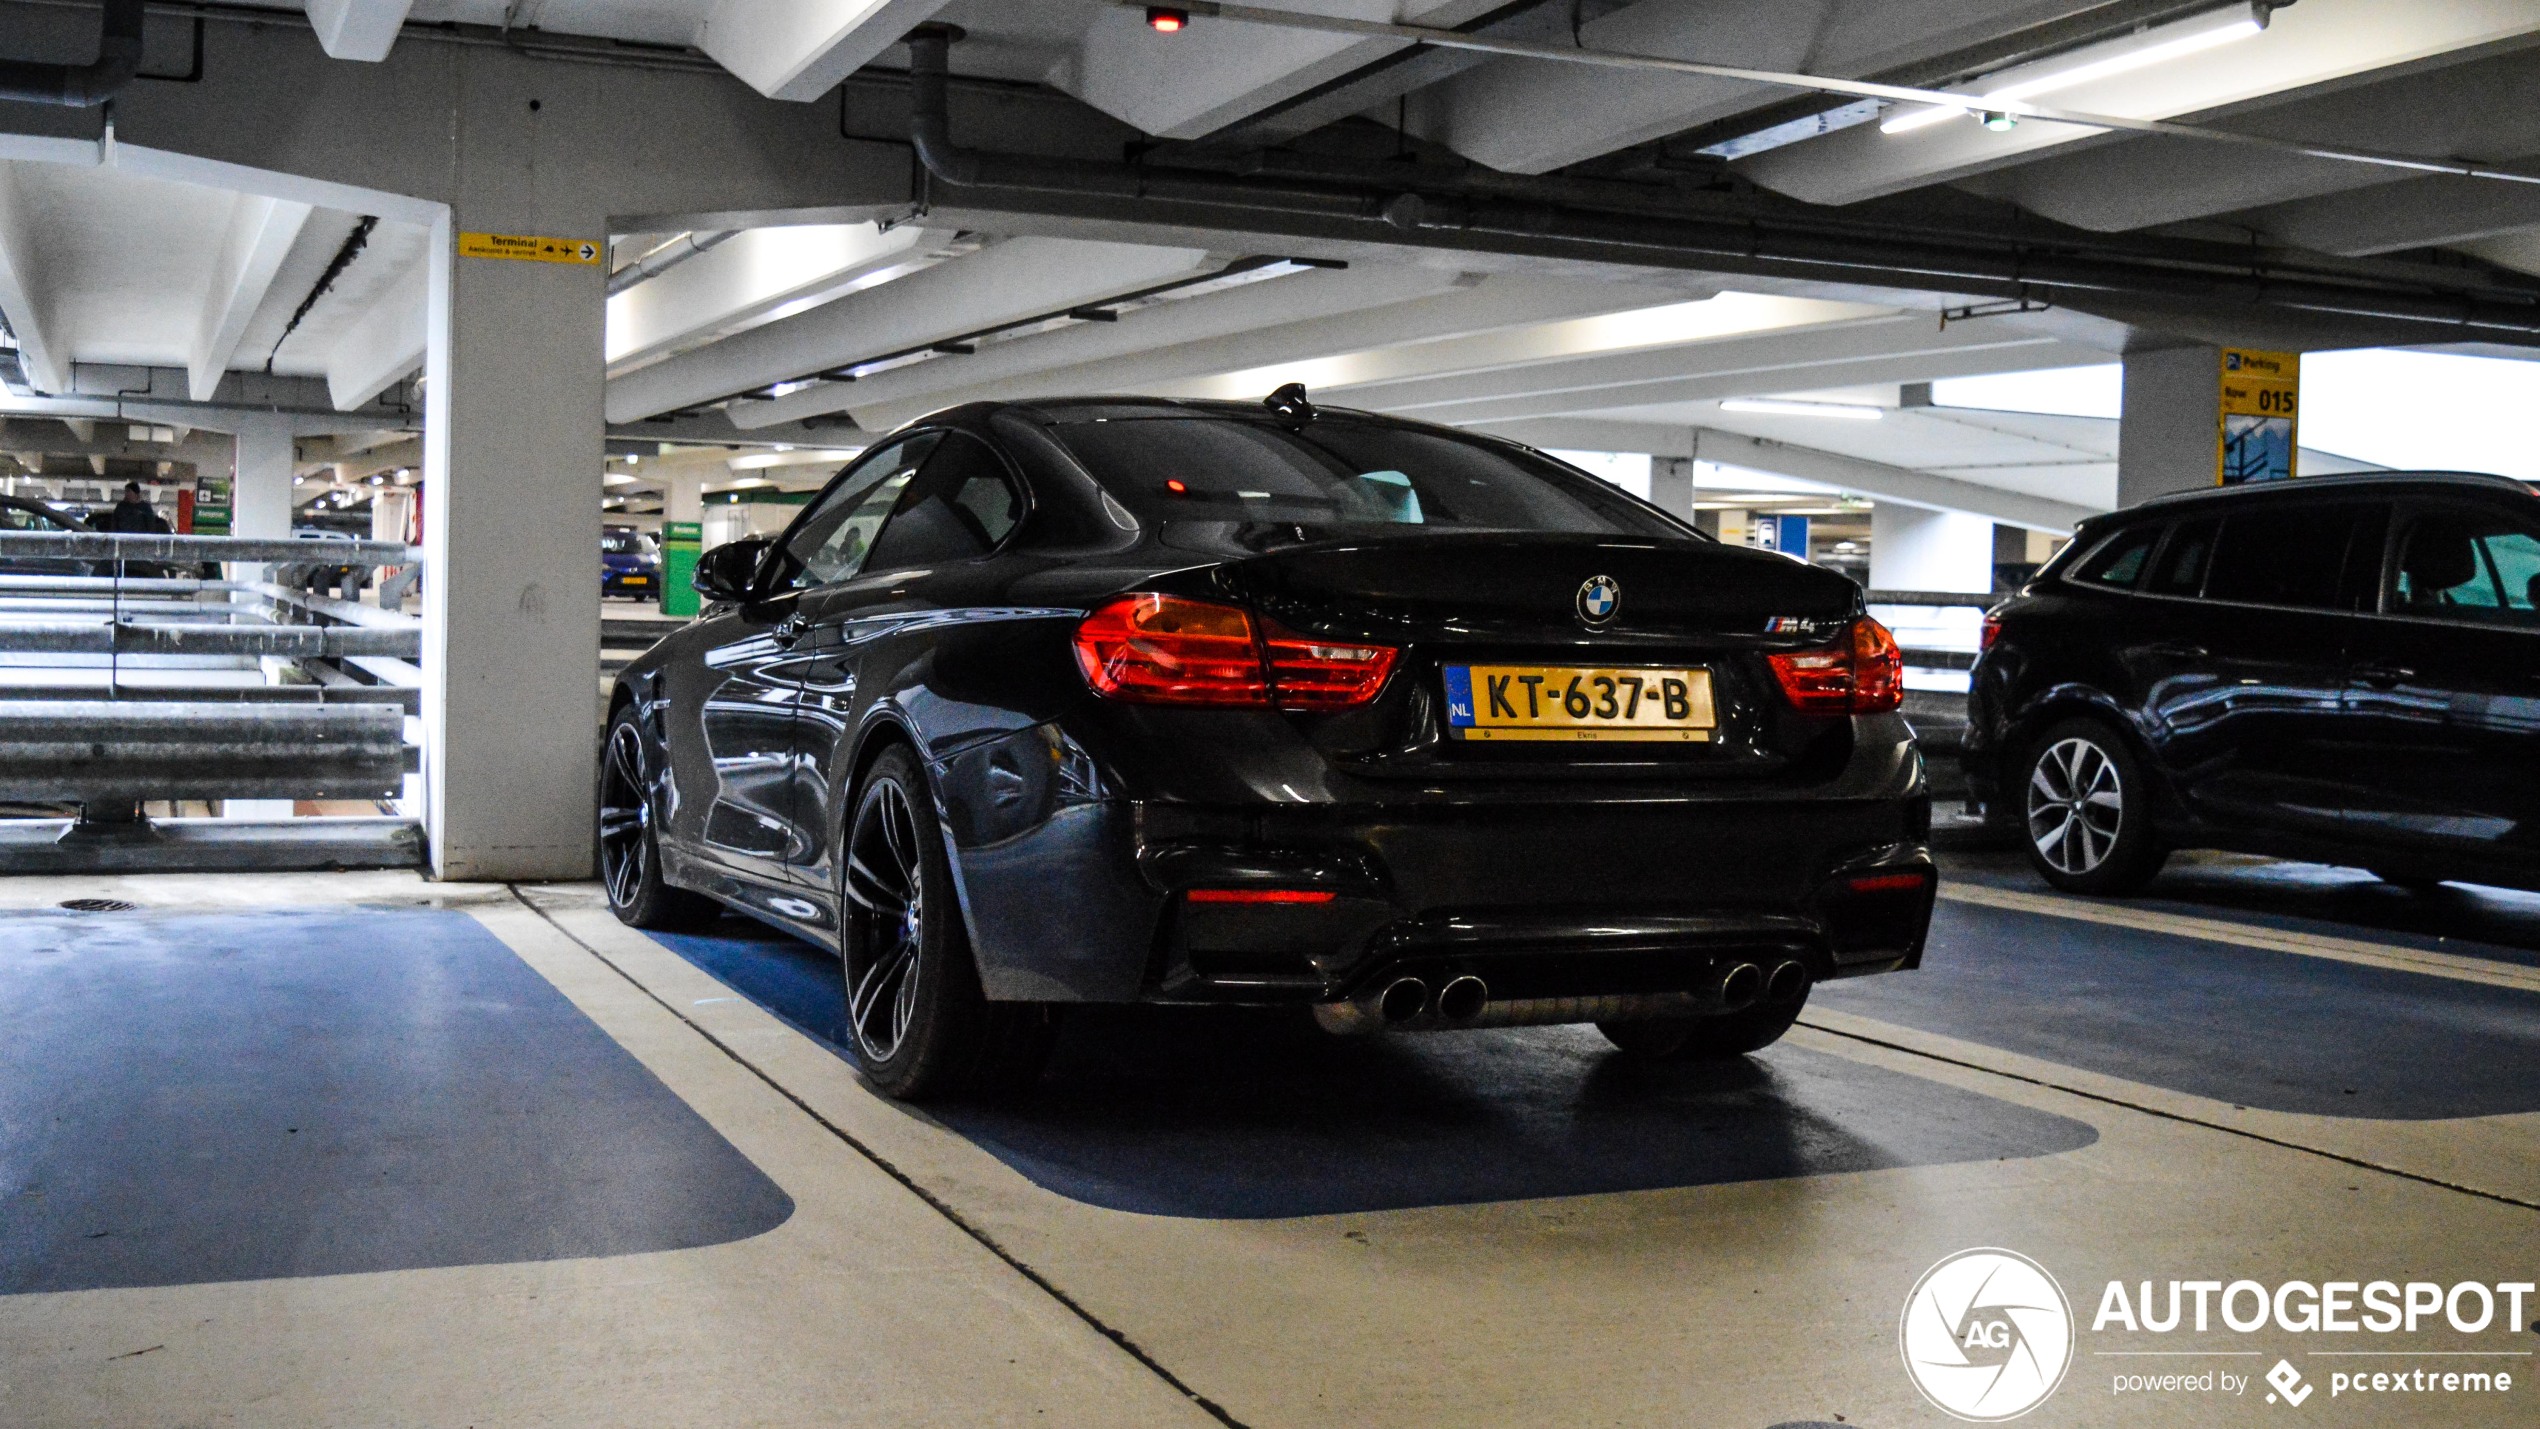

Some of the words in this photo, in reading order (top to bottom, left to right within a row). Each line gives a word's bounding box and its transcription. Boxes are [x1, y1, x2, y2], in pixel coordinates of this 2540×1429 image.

[491, 235, 537, 248] Terminal
[2243, 355, 2281, 373] Parking
[2225, 385, 2247, 398] Row
[2259, 389, 2294, 413] 015
[1452, 702, 1471, 717] NL
[1487, 674, 1691, 720] KT-637-B
[1577, 731, 1598, 739] Ekris
